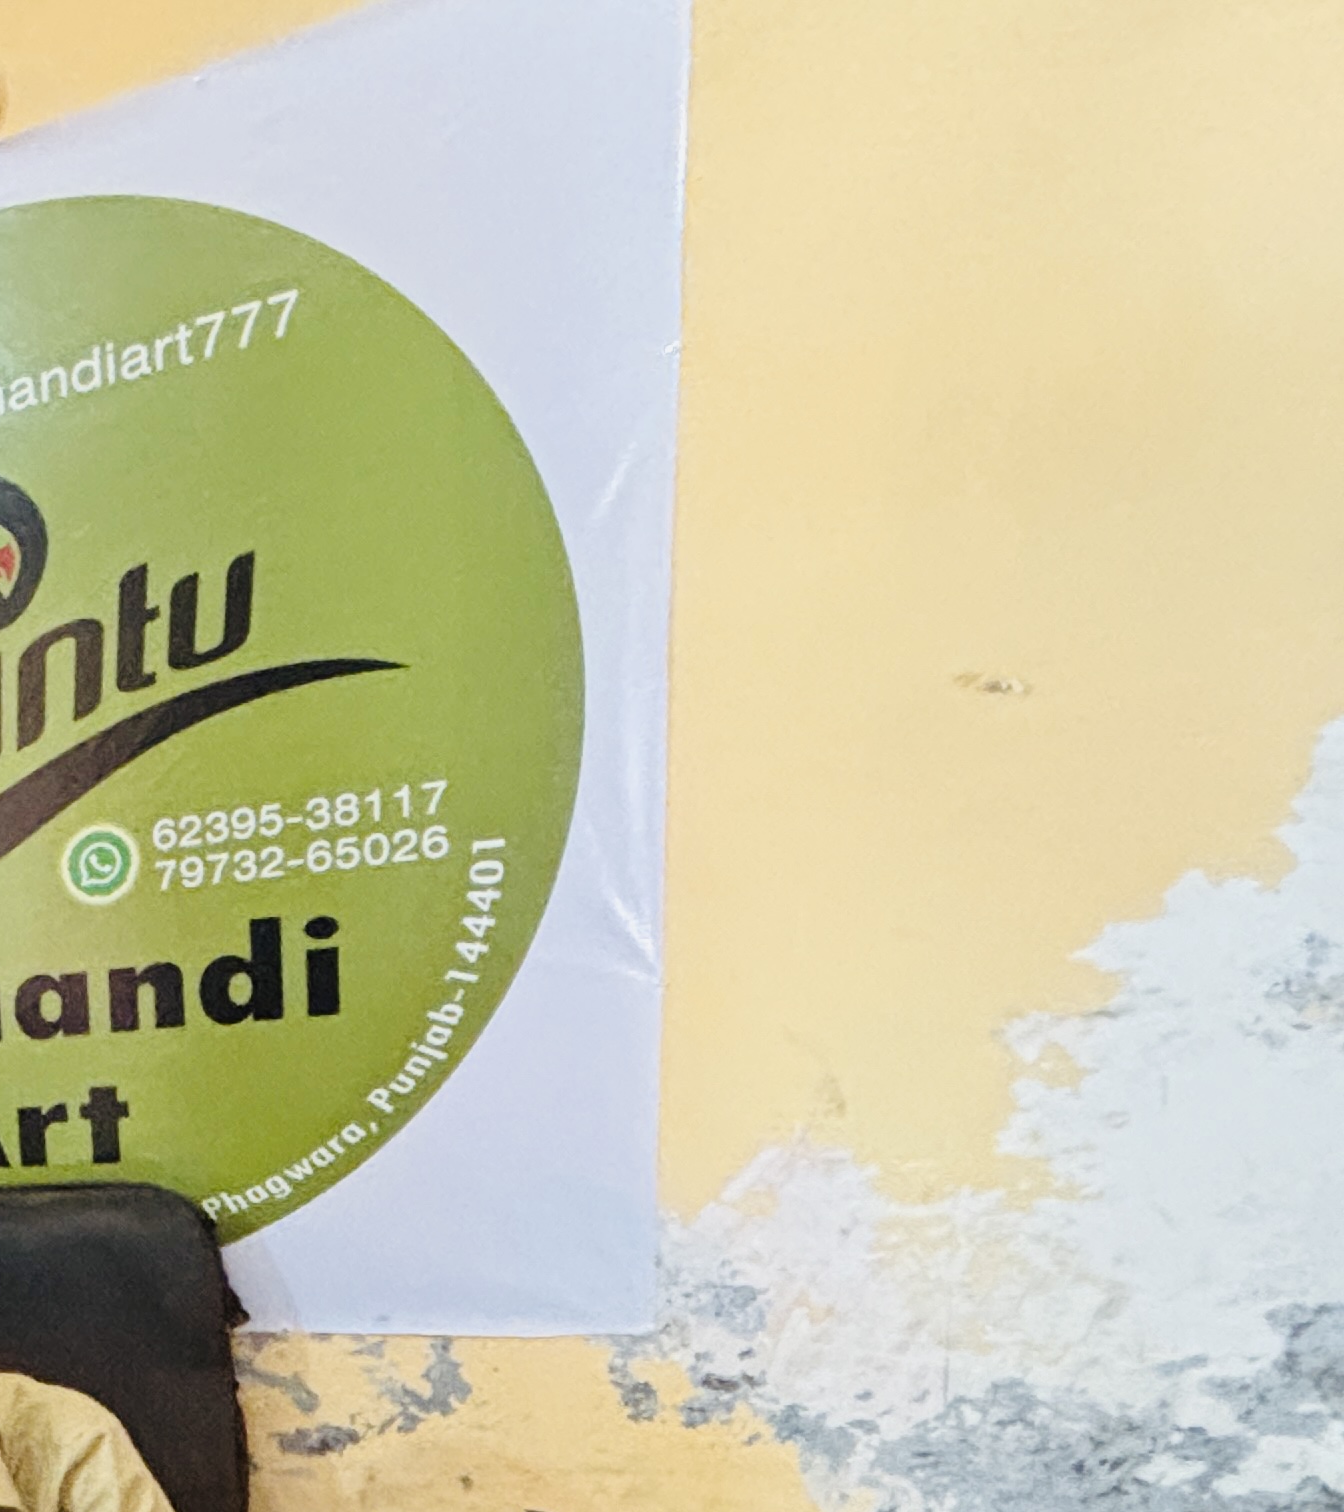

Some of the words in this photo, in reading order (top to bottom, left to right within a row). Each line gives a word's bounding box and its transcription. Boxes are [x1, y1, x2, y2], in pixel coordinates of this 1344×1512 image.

[152, 779, 448, 852] 62395-38117
[155, 825, 450, 891] 79732-65026
[201, 1119, 381, 1221] Phagwara,
[365, 837, 506, 1114] Punjab-144401
